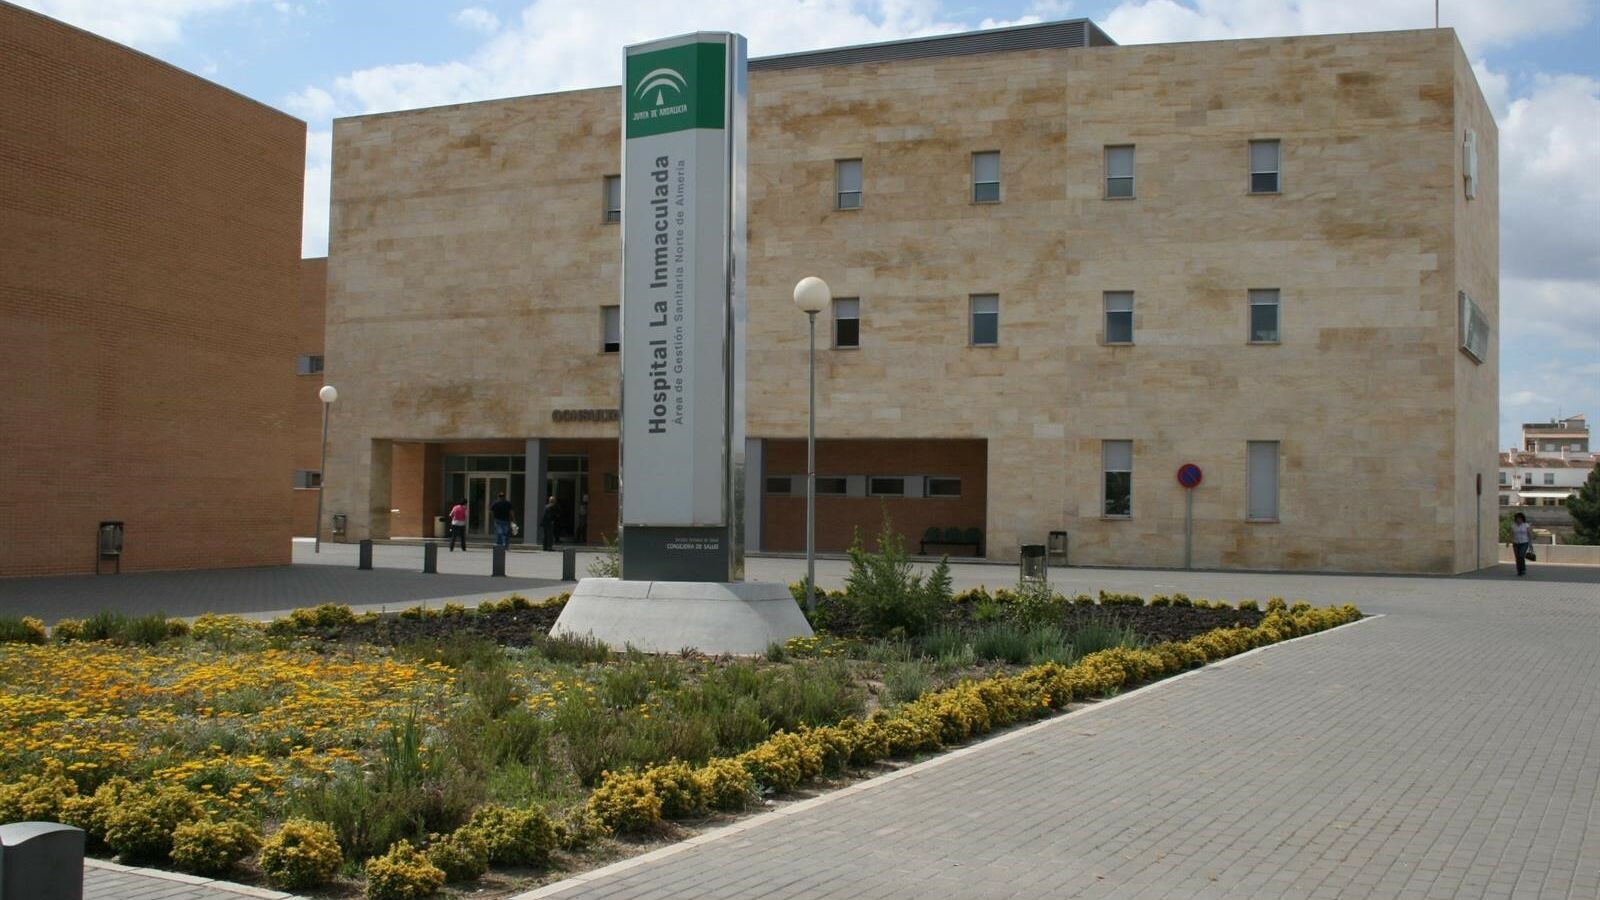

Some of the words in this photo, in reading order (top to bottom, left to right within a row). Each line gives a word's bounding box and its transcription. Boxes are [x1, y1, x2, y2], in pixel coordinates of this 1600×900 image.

[675, 160, 685, 207] Almería
[650, 156, 669, 288] Inmaculada
[675, 211, 684, 226] de
[674, 230, 684, 263] Norte
[649, 301, 668, 327] La
[673, 267, 683, 322] Sanitaria
[673, 326, 683, 374] Gestión
[648, 340, 671, 433] Hospital
[674, 378, 683, 393] de
[673, 397, 683, 425] Área
